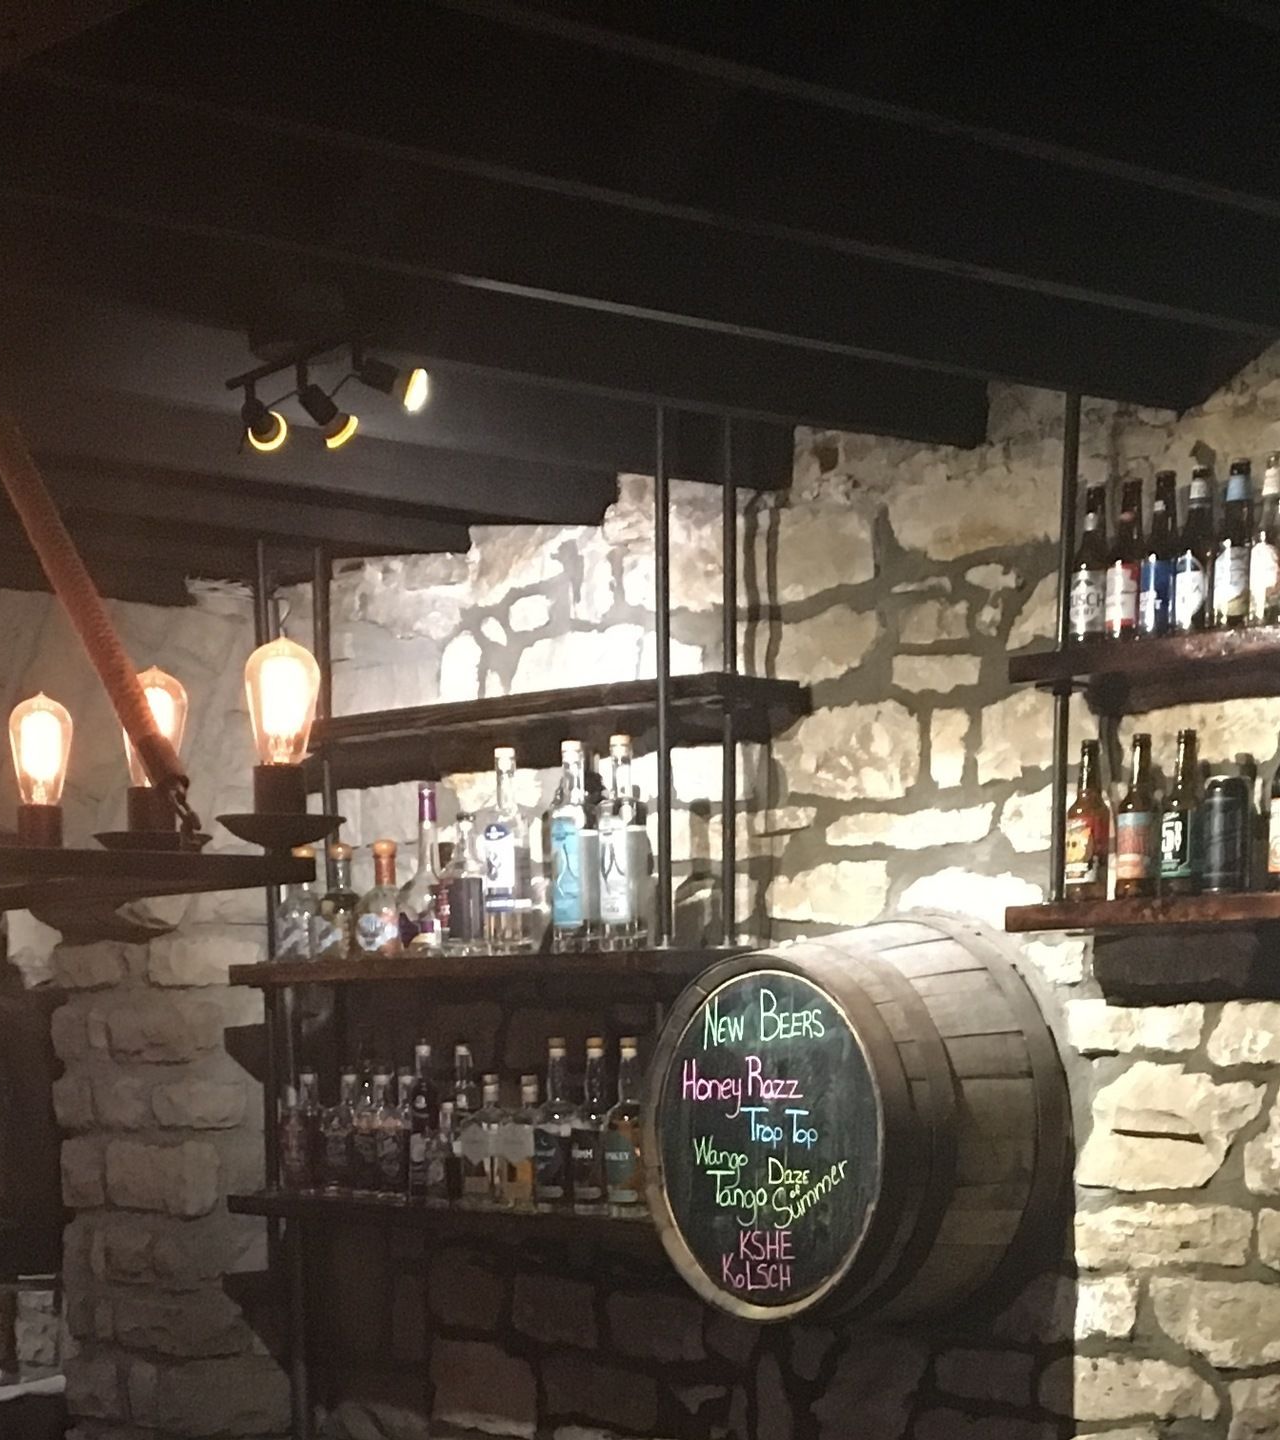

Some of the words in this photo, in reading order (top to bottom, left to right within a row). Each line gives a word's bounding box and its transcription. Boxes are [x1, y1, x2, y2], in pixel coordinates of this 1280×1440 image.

[1070, 590, 1106, 608] USCH
[760, 988, 825, 1042] BEERS
[682, 1058, 742, 1119] Honey
[744, 1055, 804, 1100] Razz
[739, 1106, 784, 1150] Trop
[784, 1108, 819, 1150] Top
[693, 1134, 749, 1189] Wango
[705, 1169, 768, 1227] Tango
[771, 1159, 848, 1229] Summer
[789, 1184, 801, 1199] of
[739, 1229, 797, 1261] KSHE
